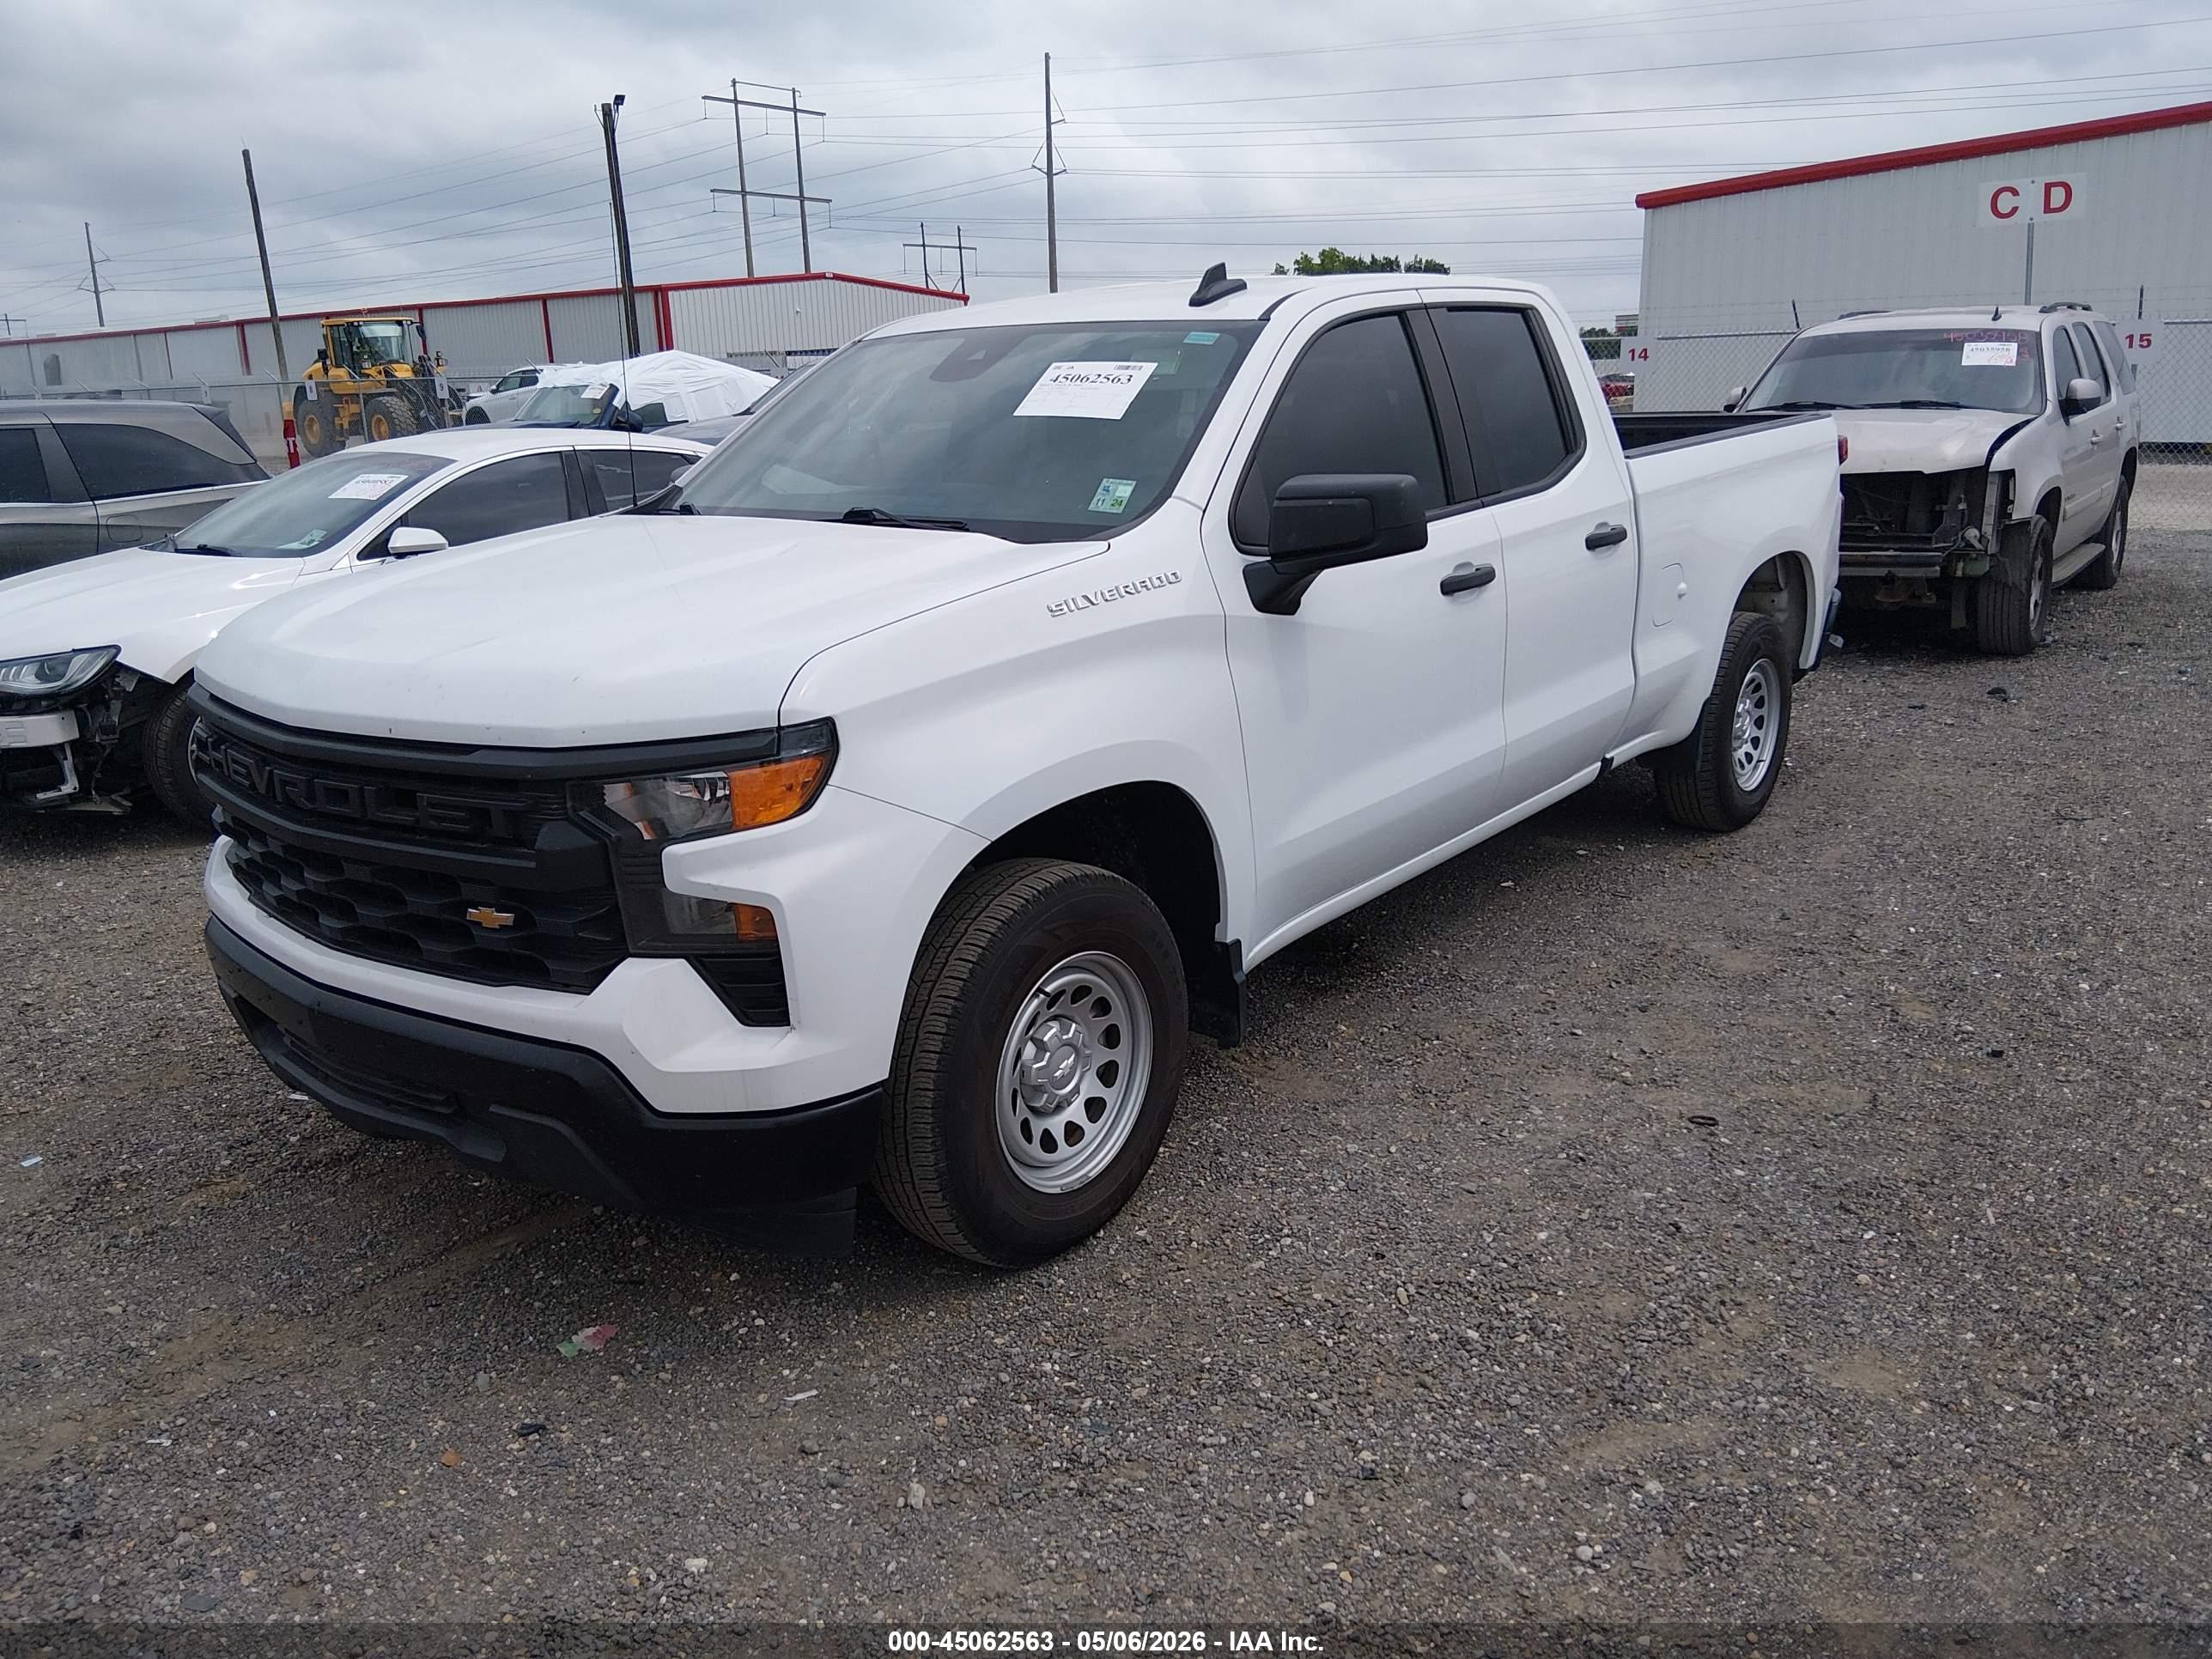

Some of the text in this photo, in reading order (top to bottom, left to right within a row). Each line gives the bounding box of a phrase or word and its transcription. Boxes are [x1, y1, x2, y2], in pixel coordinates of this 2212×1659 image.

[1990, 180, 2073, 220] C D
[2124, 333, 2152, 349] 15
[1628, 347, 1650, 362] 14
[1049, 373, 1134, 386] 45062563
[1096, 497, 1124, 508] 11 24
[1046, 569, 1183, 618] SILVERADO
[191, 724, 532, 839] CHEVROLET
